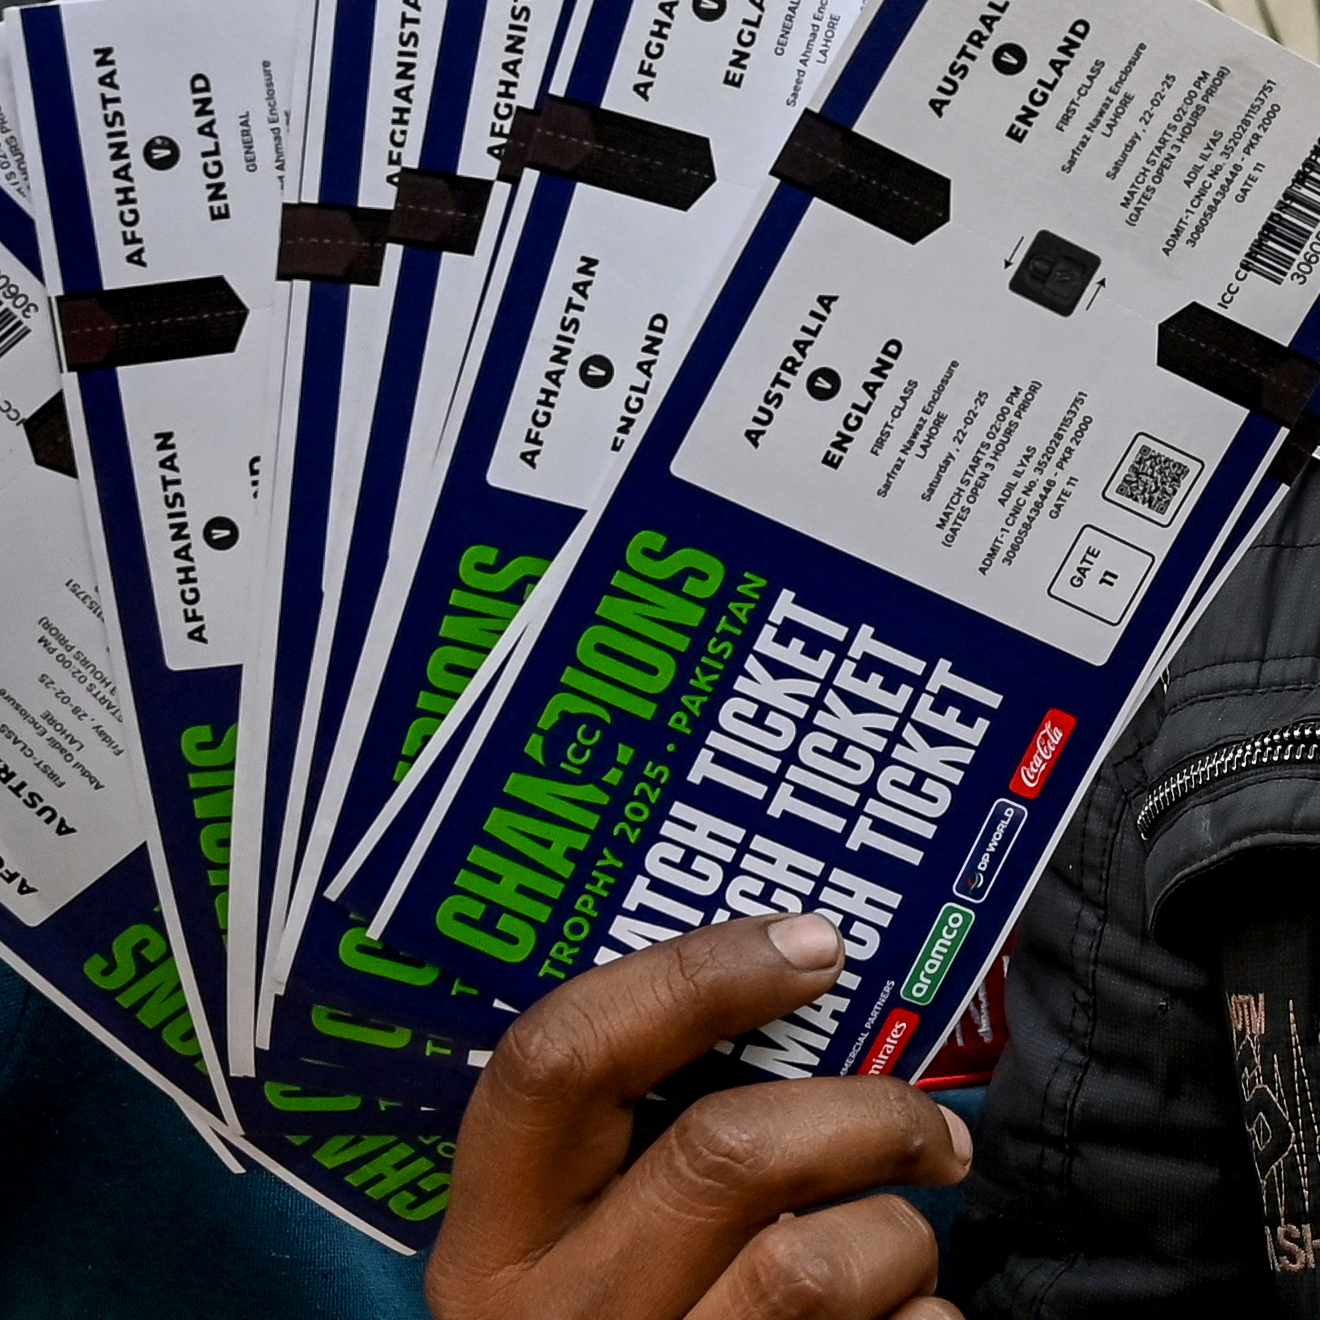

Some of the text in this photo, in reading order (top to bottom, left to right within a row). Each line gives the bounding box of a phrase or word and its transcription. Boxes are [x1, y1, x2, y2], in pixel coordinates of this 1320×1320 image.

[785, 68, 807, 108] Saeed
[798, 22, 821, 68] Ahmad
[815, 13, 841, 65] LAHORE
[261, 59, 280, 125] Enclosure
[1005, 18, 1091, 144] ENGLAND
[1054, 58, 1106, 133] FIRST-CLASS
[1060, 42, 1148, 175] Sarfraz Nawaz Enclosure
[1100, 91, 1136, 139] LAHORE
[92, 46, 148, 269] AFGHANISTAN
[189, 72, 231, 222] ENGLAND
[238, 110, 258, 173] GENERAL
[269, 126, 286, 172] Ahmad
[1105, 73, 1177, 181] Saturday 22-02-25
[1119, 69, 1211, 210] MATCH STARTS 02:00 PM
[1124, 65, 1231, 227] (GATES OPEN 3 HOURS PRIOR)
[1183, 129, 1224, 190] ADIL ILYAS
[1242, 132, 1264, 157] PKR
[1256, 103, 1282, 134] 2000
[1161, 208, 1196, 257] ADMIT-1
[1189, 179, 1213, 209] CNIC
[1206, 162, 1226, 181] No.
[1234, 161, 1266, 204] GATE 11
[1216, 282, 1240, 310] ICC
[519, 255, 600, 470] AFGHANISTAN
[610, 312, 669, 453] ENGLAND
[743, 294, 840, 450] AUSTRALIA
[820, 338, 903, 471] ENGLAND
[869, 378, 919, 457] FIRST-CLASS
[876, 359, 960, 499] Sarfraz Nawaz Enclosure
[914, 410, 949, 460] LAHORE
[1055, 445, 1076, 471] PKR
[1069, 415, 1094, 447] 2000
[920, 390, 989, 503] Saturday 22-02-25
[935, 385, 1023, 531] MATCH STARTS 02:00 PM
[940, 380, 1043, 548] (GATES OPEN 3 HOURS PRIOR)
[977, 390, 1088, 577] ADMIT-1 CNIC No. 3520281153751
[997, 445, 1037, 508] ADIL ILYAS
[1048, 475, 1080, 520] GATE 11
[153, 430, 209, 645] AFGHANISTAN
[1069, 545, 1101, 589] GATE
[1098, 569, 1119, 587] 11
[36, 635, 88, 685] 02:00 PM
[37, 616, 113, 689] HOURS PRIOR)
[37, 673, 125, 757] Friday 28-02-25
[39, 709, 85, 752] LAHORE
[45, 736, 75, 764] Qadir
[559, 723, 602, 775] ICC
[769, 622, 927, 831] TICKET
[71, 761, 106, 791] Abdul
[537, 571, 768, 980] TROPHY 2025 PAKISTAN
[593, 791, 748, 962] ATCH
[686, 587, 850, 800] TICKET
[846, 656, 1004, 863] TICKET
[1020, 720, 1064, 788] Coca-Cola
[977, 807, 1015, 872] DP WORLD
[911, 903, 964, 998] aramco
[864, 979, 896, 1030] PARTNERS
[868, 1021, 907, 1075] mirates
